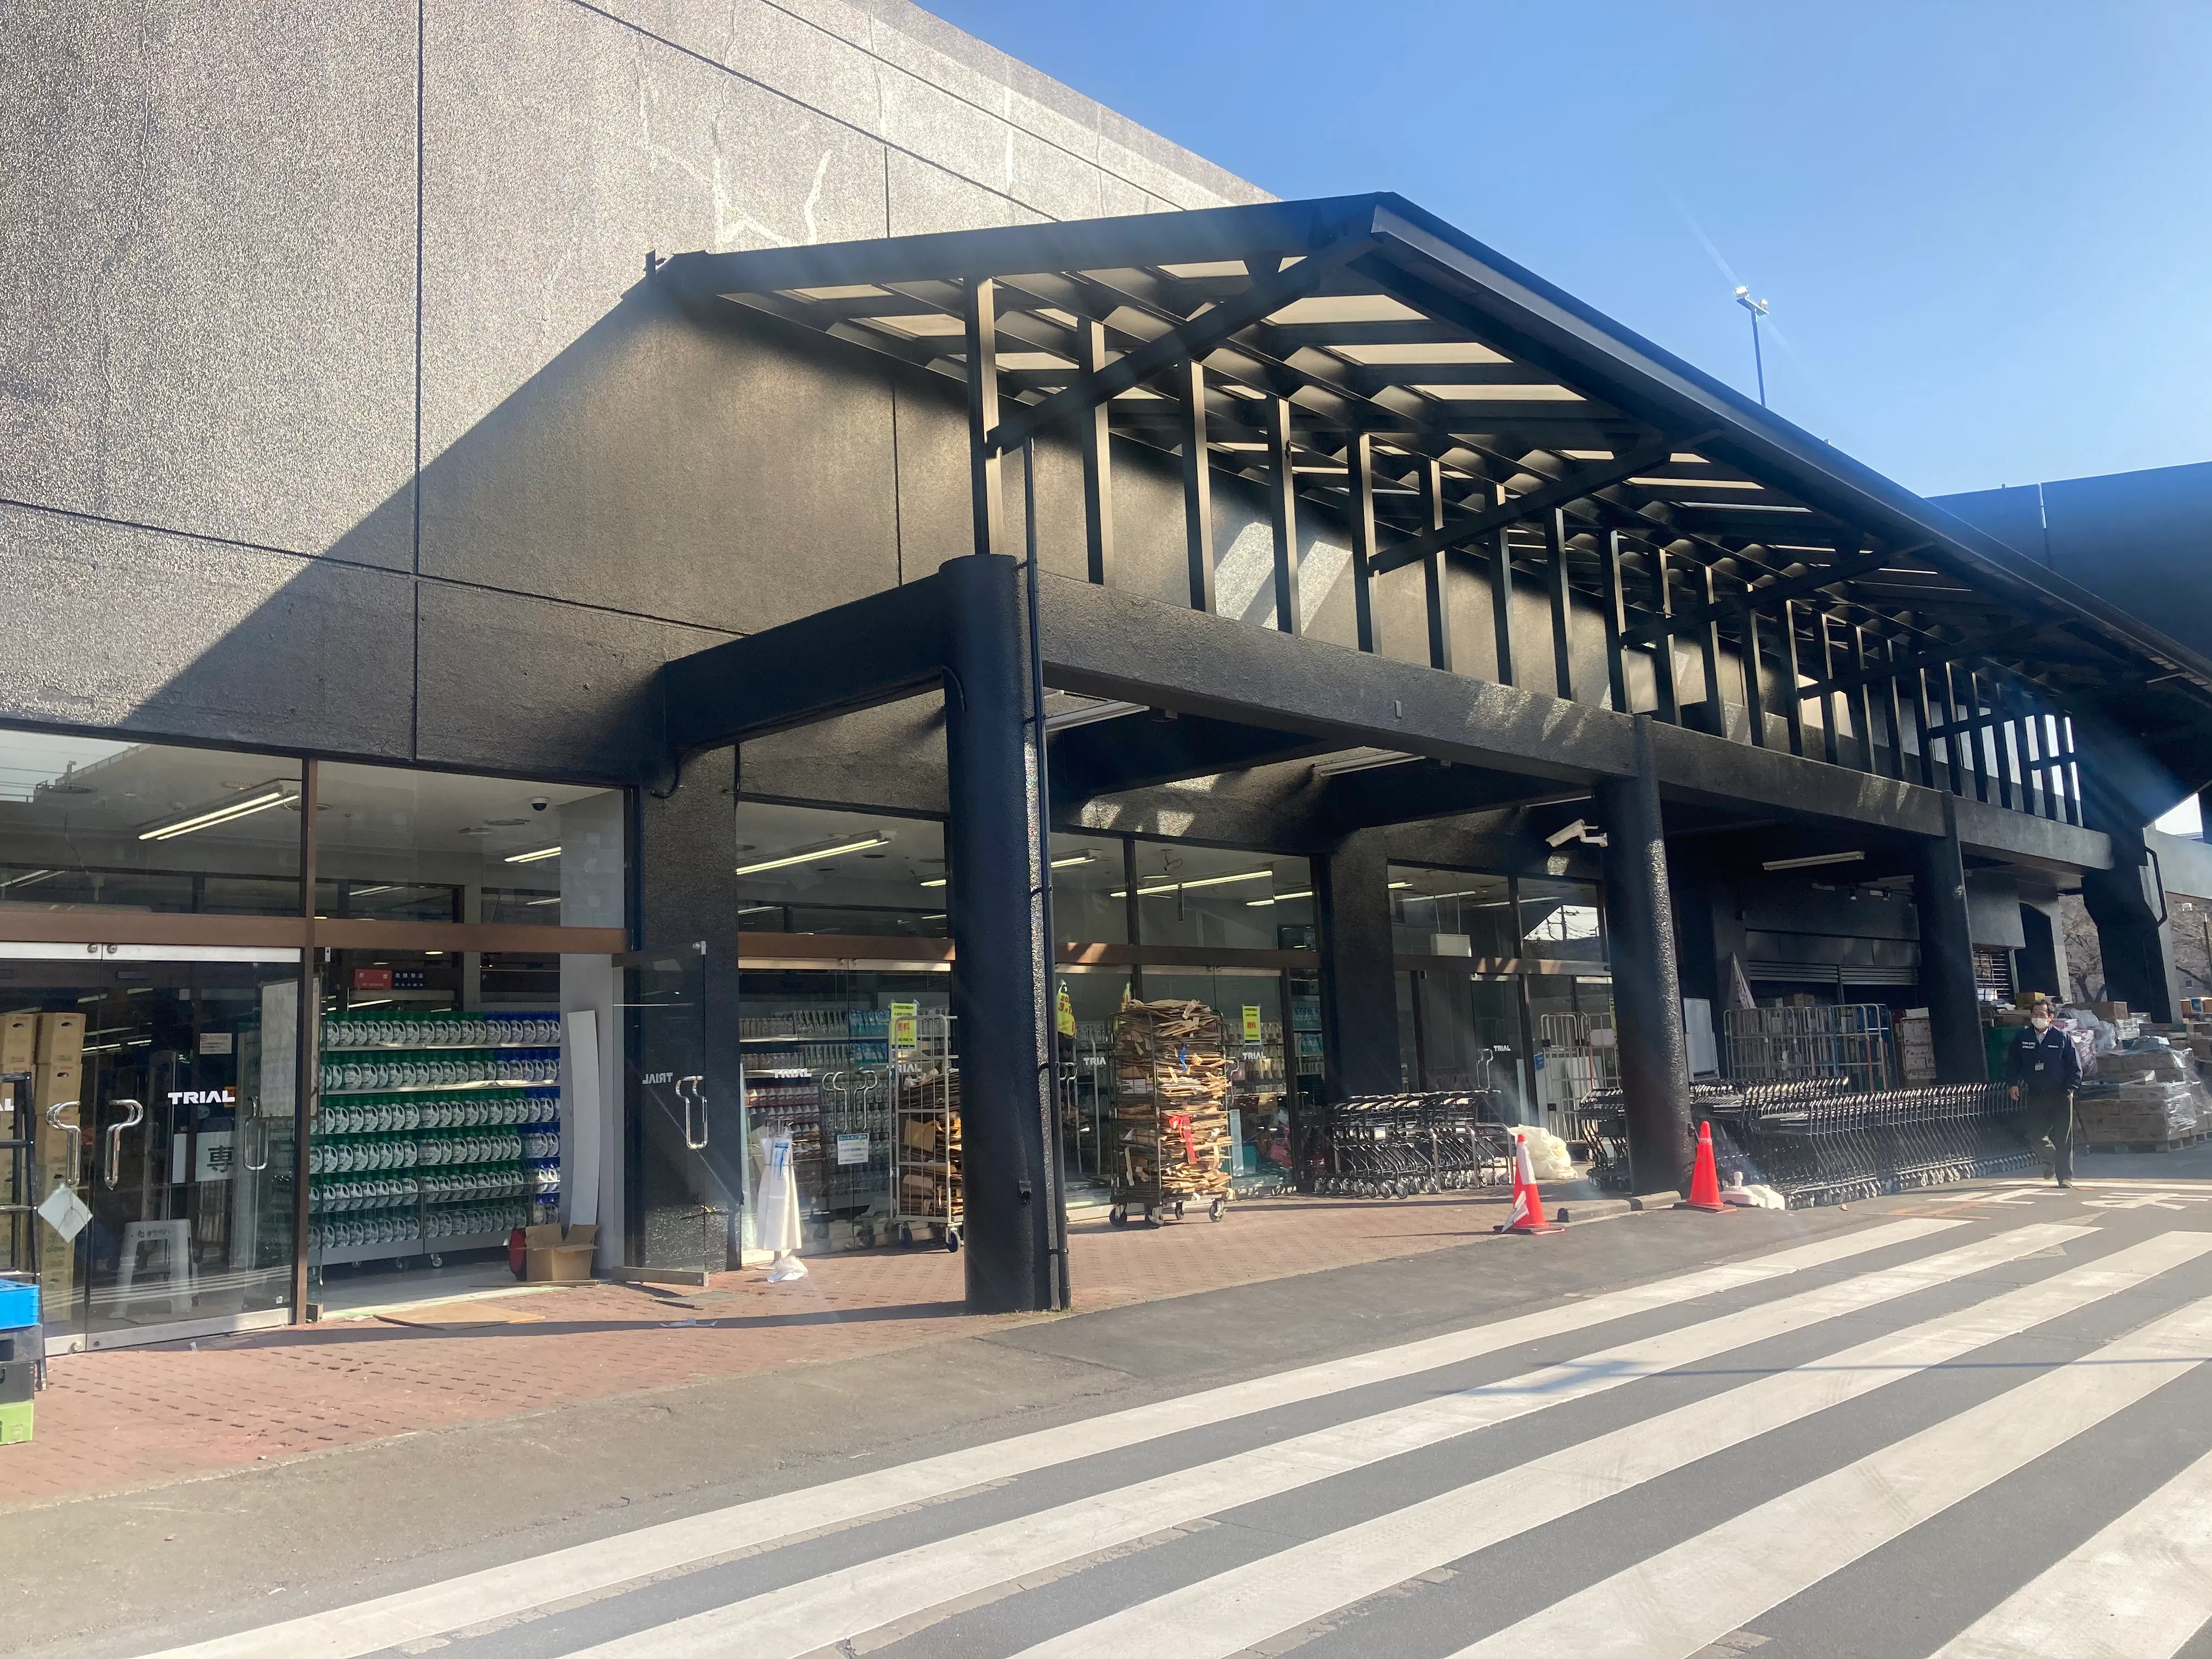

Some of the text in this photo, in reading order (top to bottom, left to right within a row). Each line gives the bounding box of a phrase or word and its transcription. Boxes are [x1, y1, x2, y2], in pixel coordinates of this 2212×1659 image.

[1084, 1057, 1107, 1065] TRIA
[1242, 1051, 1266, 1060] TRIAL
[772, 1068, 812, 1079] TRIAL
[168, 1091, 235, 1104] TRIAL
[207, 1146, 235, 1172] 専
